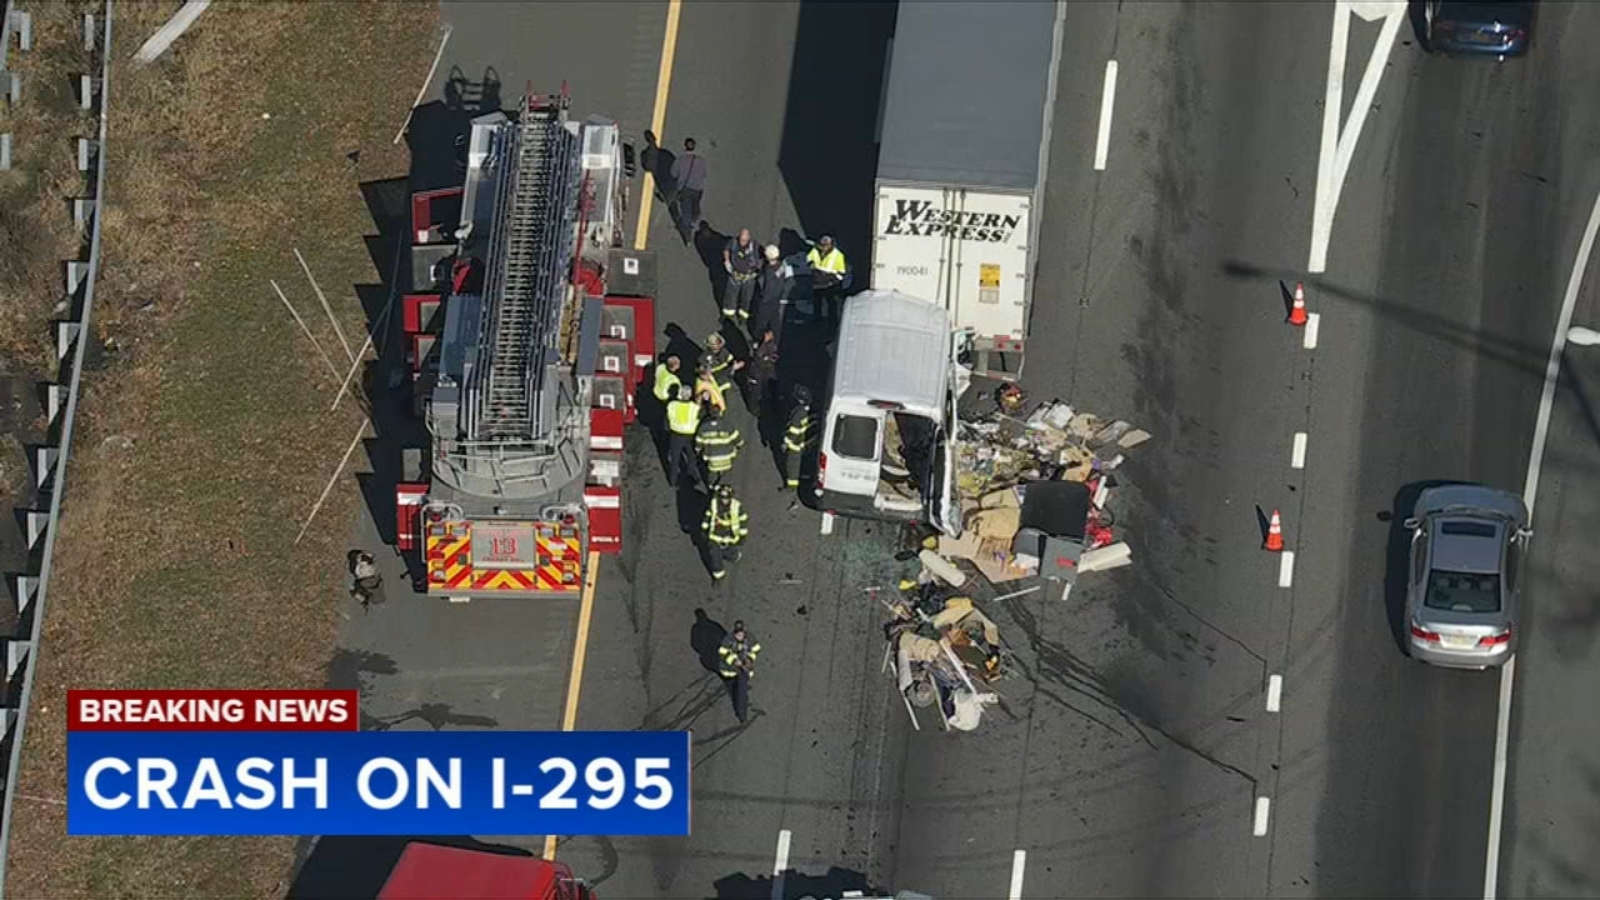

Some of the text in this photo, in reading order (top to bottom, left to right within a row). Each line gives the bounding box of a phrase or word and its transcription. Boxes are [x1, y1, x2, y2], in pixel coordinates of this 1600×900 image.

[895, 199, 1021, 229] WESTERN
[884, 214, 1005, 242] EXPRESS
[896, 265, 929, 276] 190041
[493, 537, 516, 555] 13
